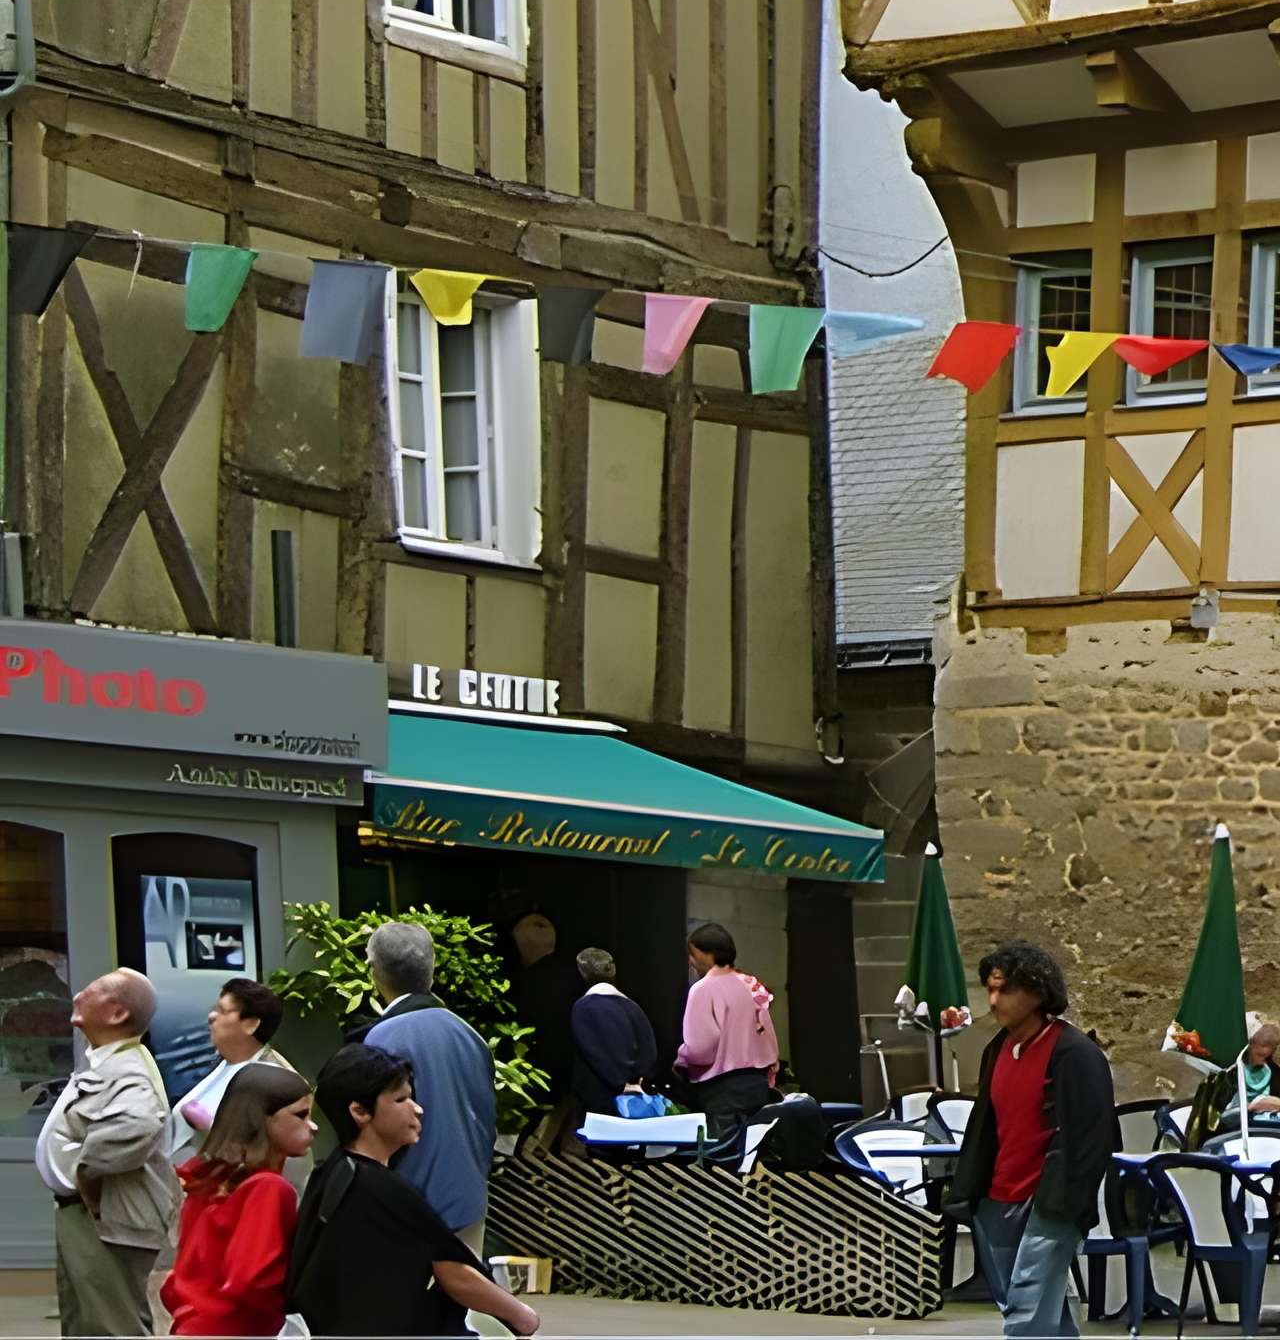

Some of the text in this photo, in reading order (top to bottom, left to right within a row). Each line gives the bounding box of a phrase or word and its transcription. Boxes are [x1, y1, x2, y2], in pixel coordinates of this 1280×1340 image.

[0, 646, 208, 716] Photo
[413, 663, 561, 716] LE CENTRE
